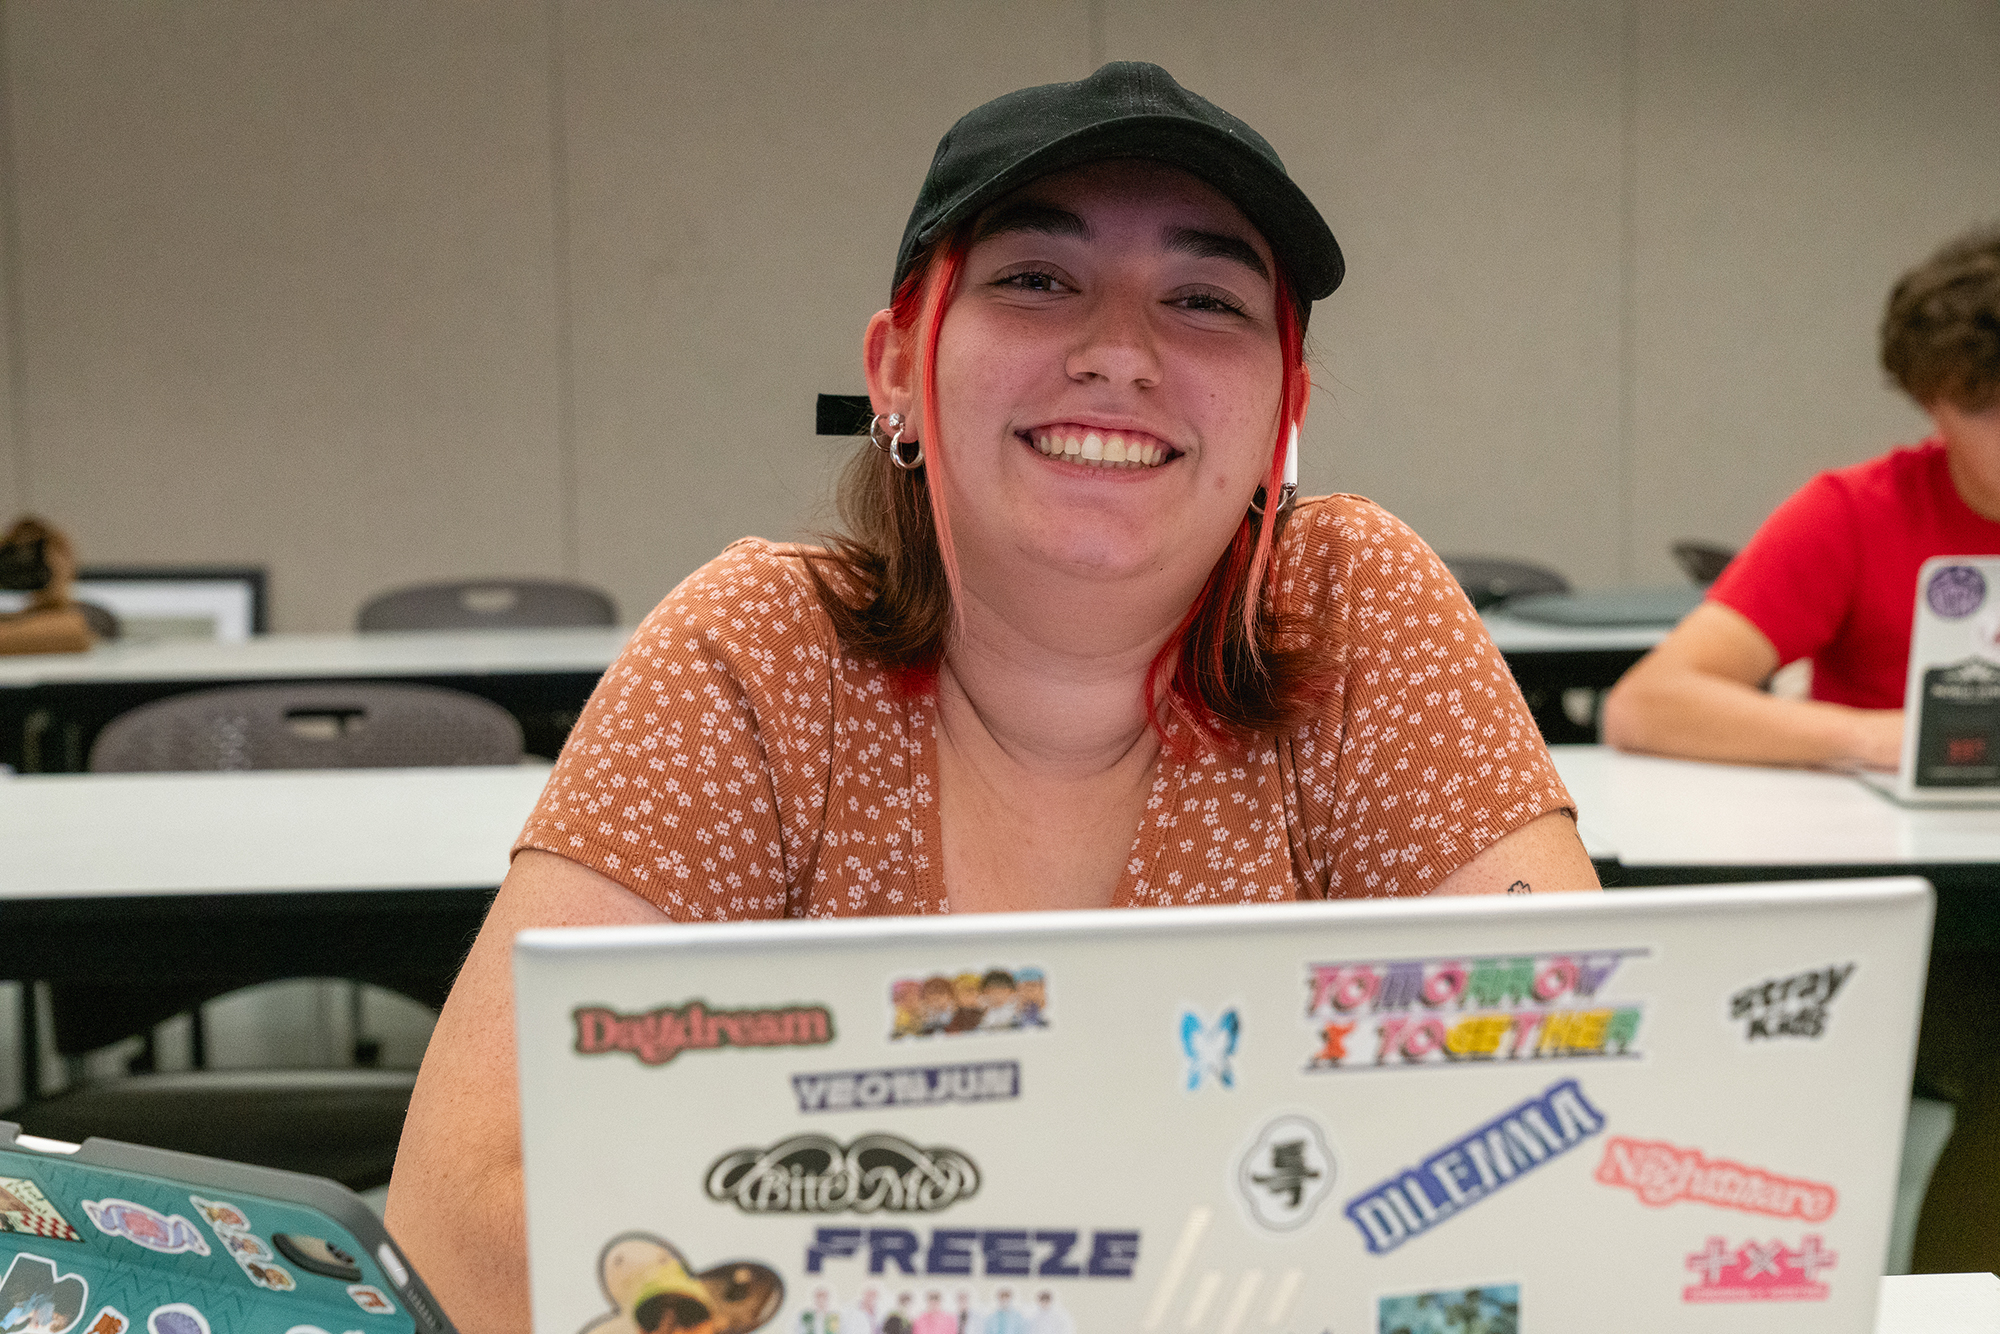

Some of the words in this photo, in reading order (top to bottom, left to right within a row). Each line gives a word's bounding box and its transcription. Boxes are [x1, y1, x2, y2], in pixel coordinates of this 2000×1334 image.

[1305, 954, 1622, 1016] TOMORROW
[574, 1000, 834, 1066] Daydream
[1374, 1005, 1642, 1066] TOGETHER
[797, 1067, 1015, 1106] YEONJUN
[1352, 1086, 1601, 1250] DILEMMA
[1597, 1137, 1837, 1222] Nightmare
[805, 1228, 1140, 1276] FREEZE
